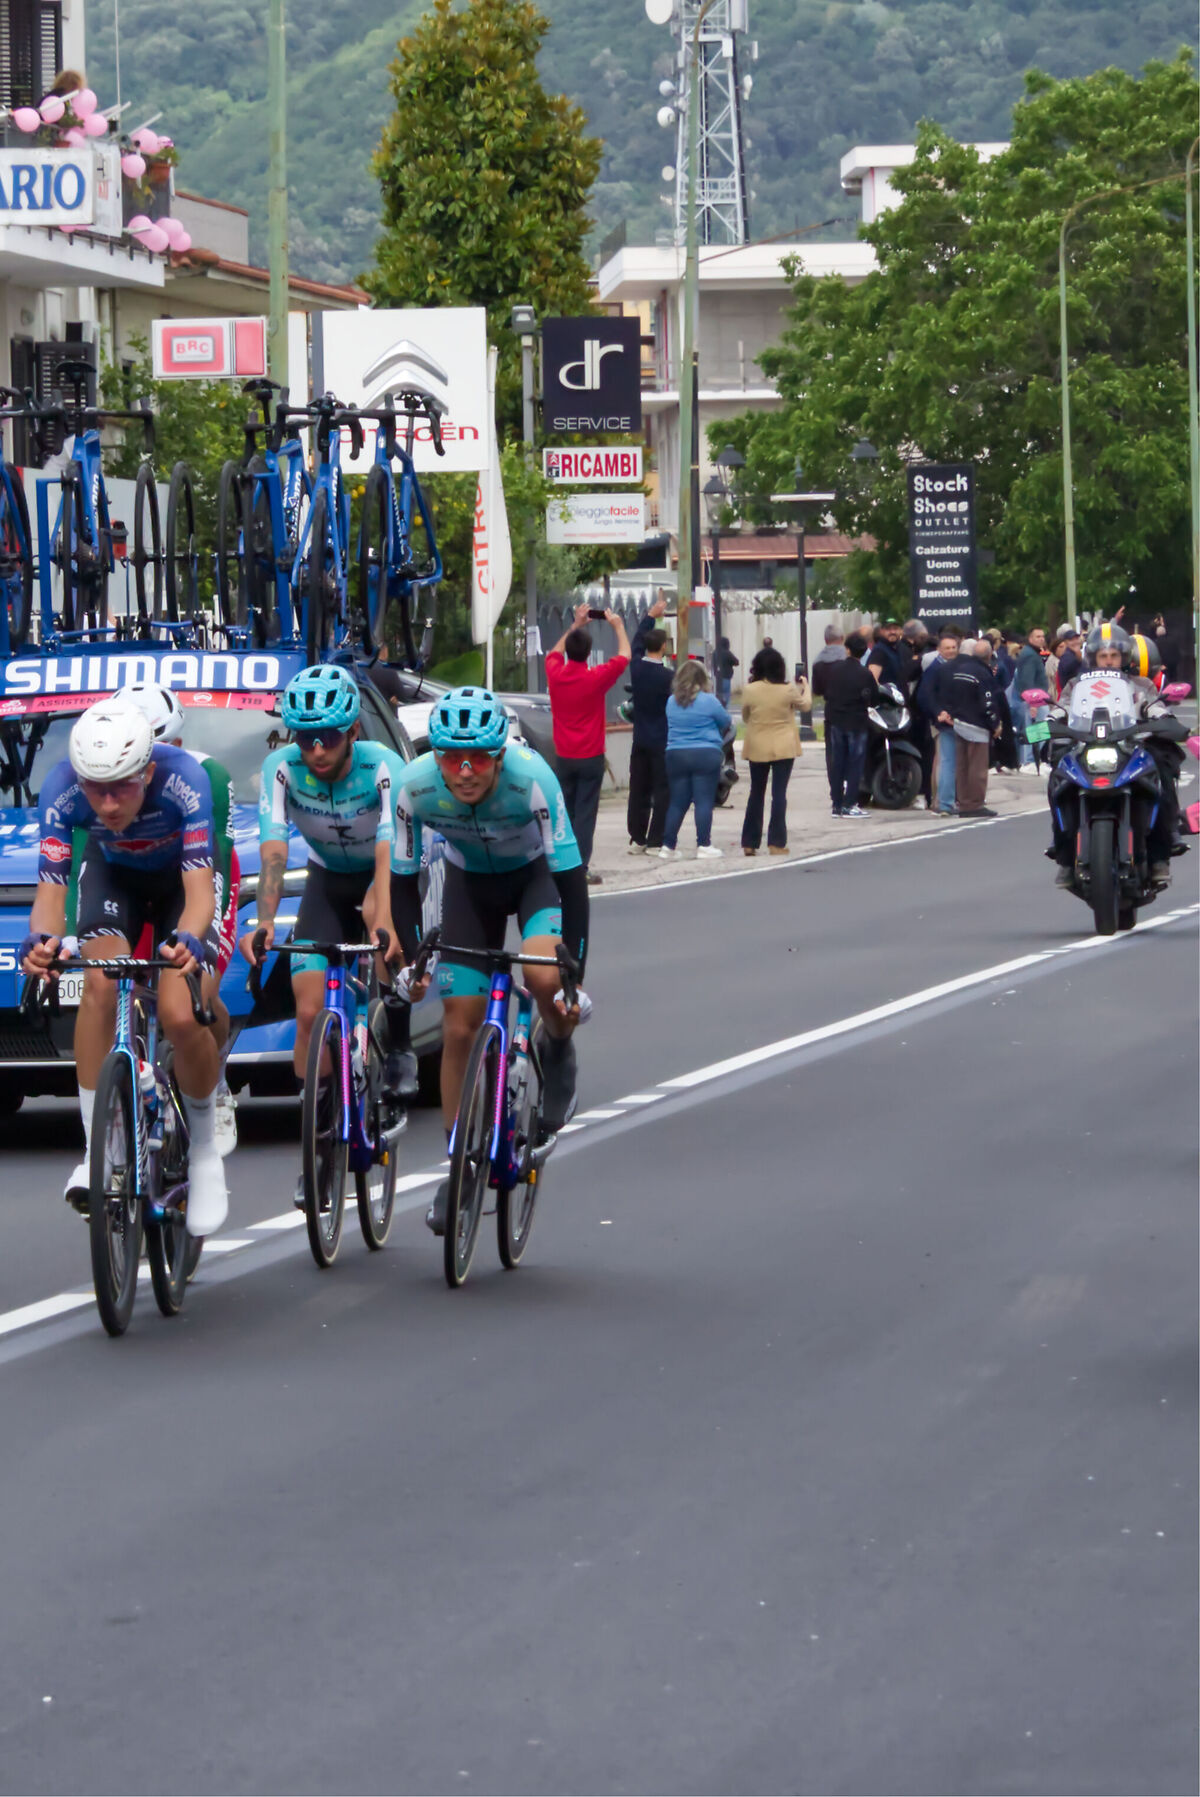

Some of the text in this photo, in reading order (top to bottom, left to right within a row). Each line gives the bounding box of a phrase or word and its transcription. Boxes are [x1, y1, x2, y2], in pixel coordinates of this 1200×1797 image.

[176, 340, 209, 354] BRC
[558, 339, 624, 391] dr
[553, 416, 631, 431] SERVICE
[561, 453, 638, 478] RICAMBI
[914, 474, 968, 493] Stock
[914, 497, 969, 514] Shoes
[566, 506, 640, 519] oleggiofacile
[915, 517, 969, 527] OUTLET
[915, 545, 970, 555] Calzature
[926, 560, 960, 569] Uomo
[925, 574, 961, 583] Donna
[919, 588, 969, 598] Bambino
[918, 606, 972, 617] Accessori
[5, 654, 280, 694] SHIMANO
[1080, 669, 1121, 681] SUZUKI
[164, 773, 200, 815] Alpecin
[40, 842, 70, 855] Alpecin
